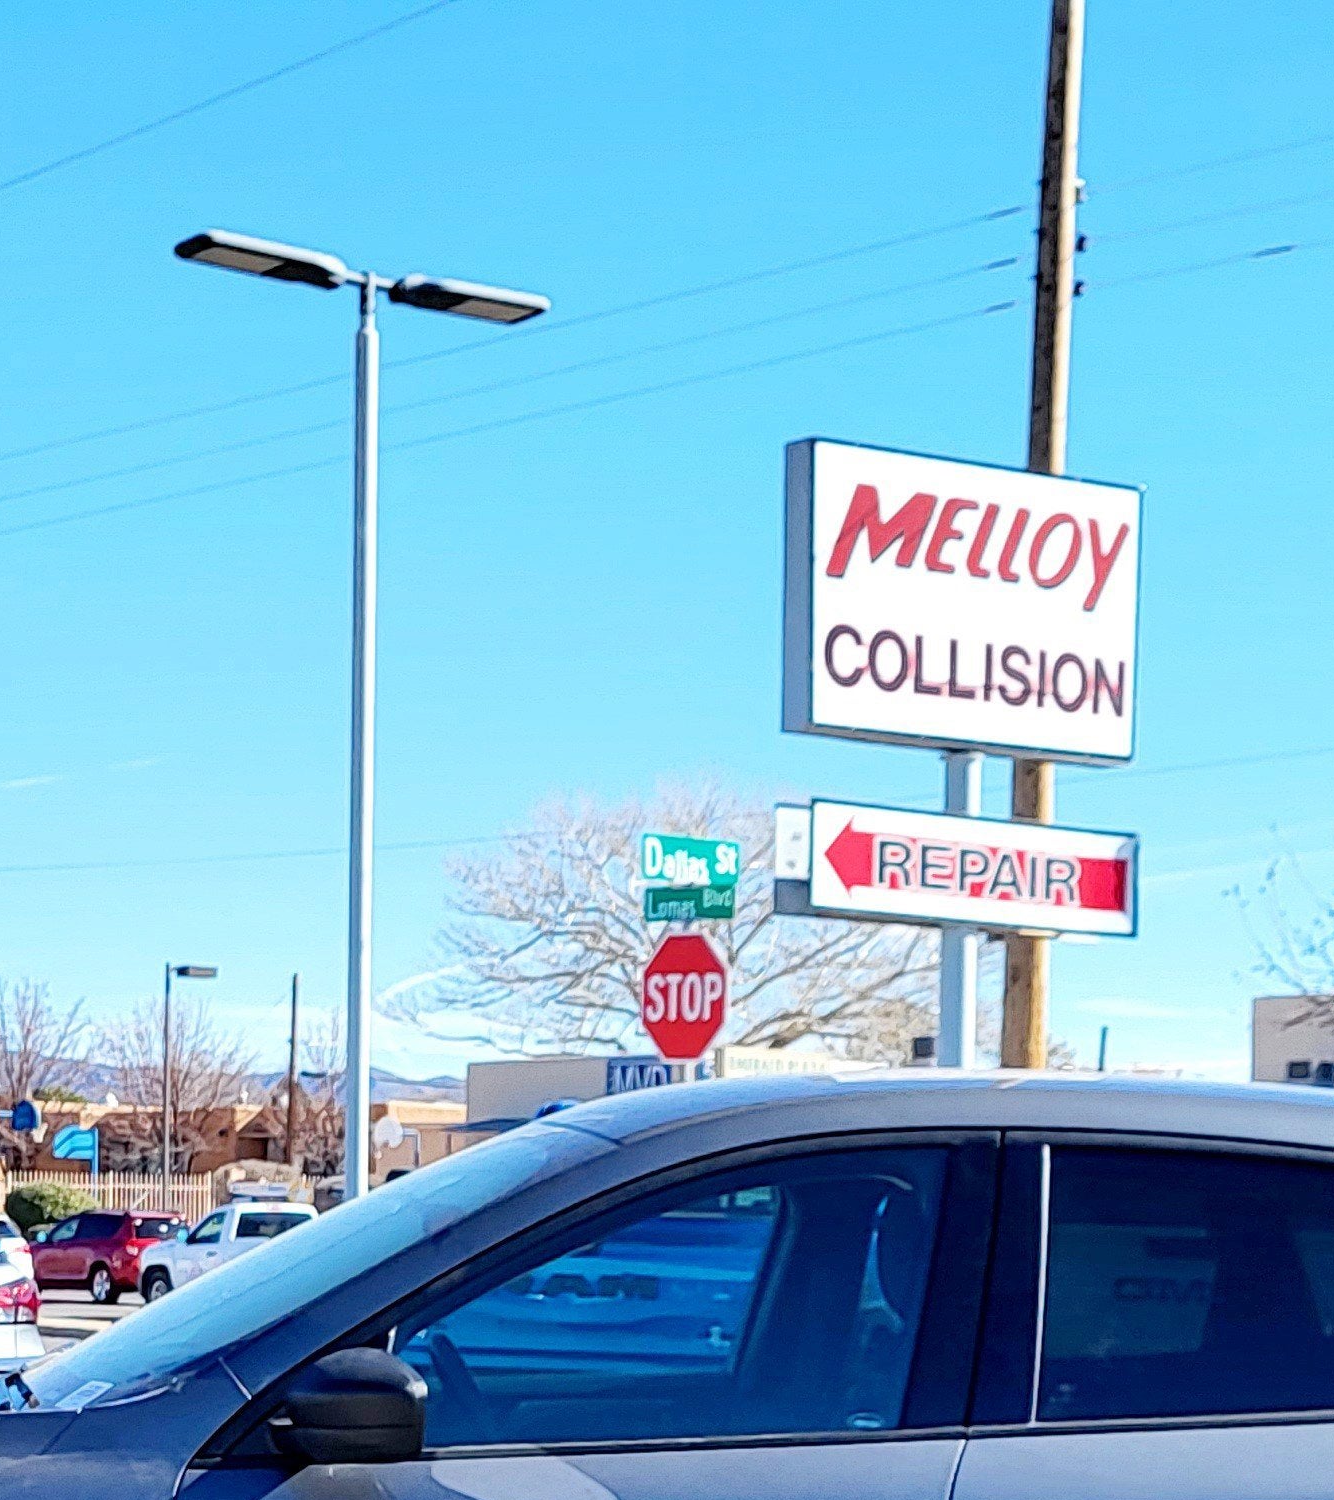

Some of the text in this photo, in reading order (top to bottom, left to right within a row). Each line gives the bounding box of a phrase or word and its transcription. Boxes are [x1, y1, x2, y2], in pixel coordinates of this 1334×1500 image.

[825, 483, 1130, 612] MELLOY
[824, 623, 1126, 718] COLLISION
[644, 836, 738, 886] Dallas St
[878, 839, 1076, 903] REPAIR
[646, 888, 733, 919] Lomas Blvd
[646, 971, 723, 1023] STOP
[611, 1063, 669, 1093] MVD
